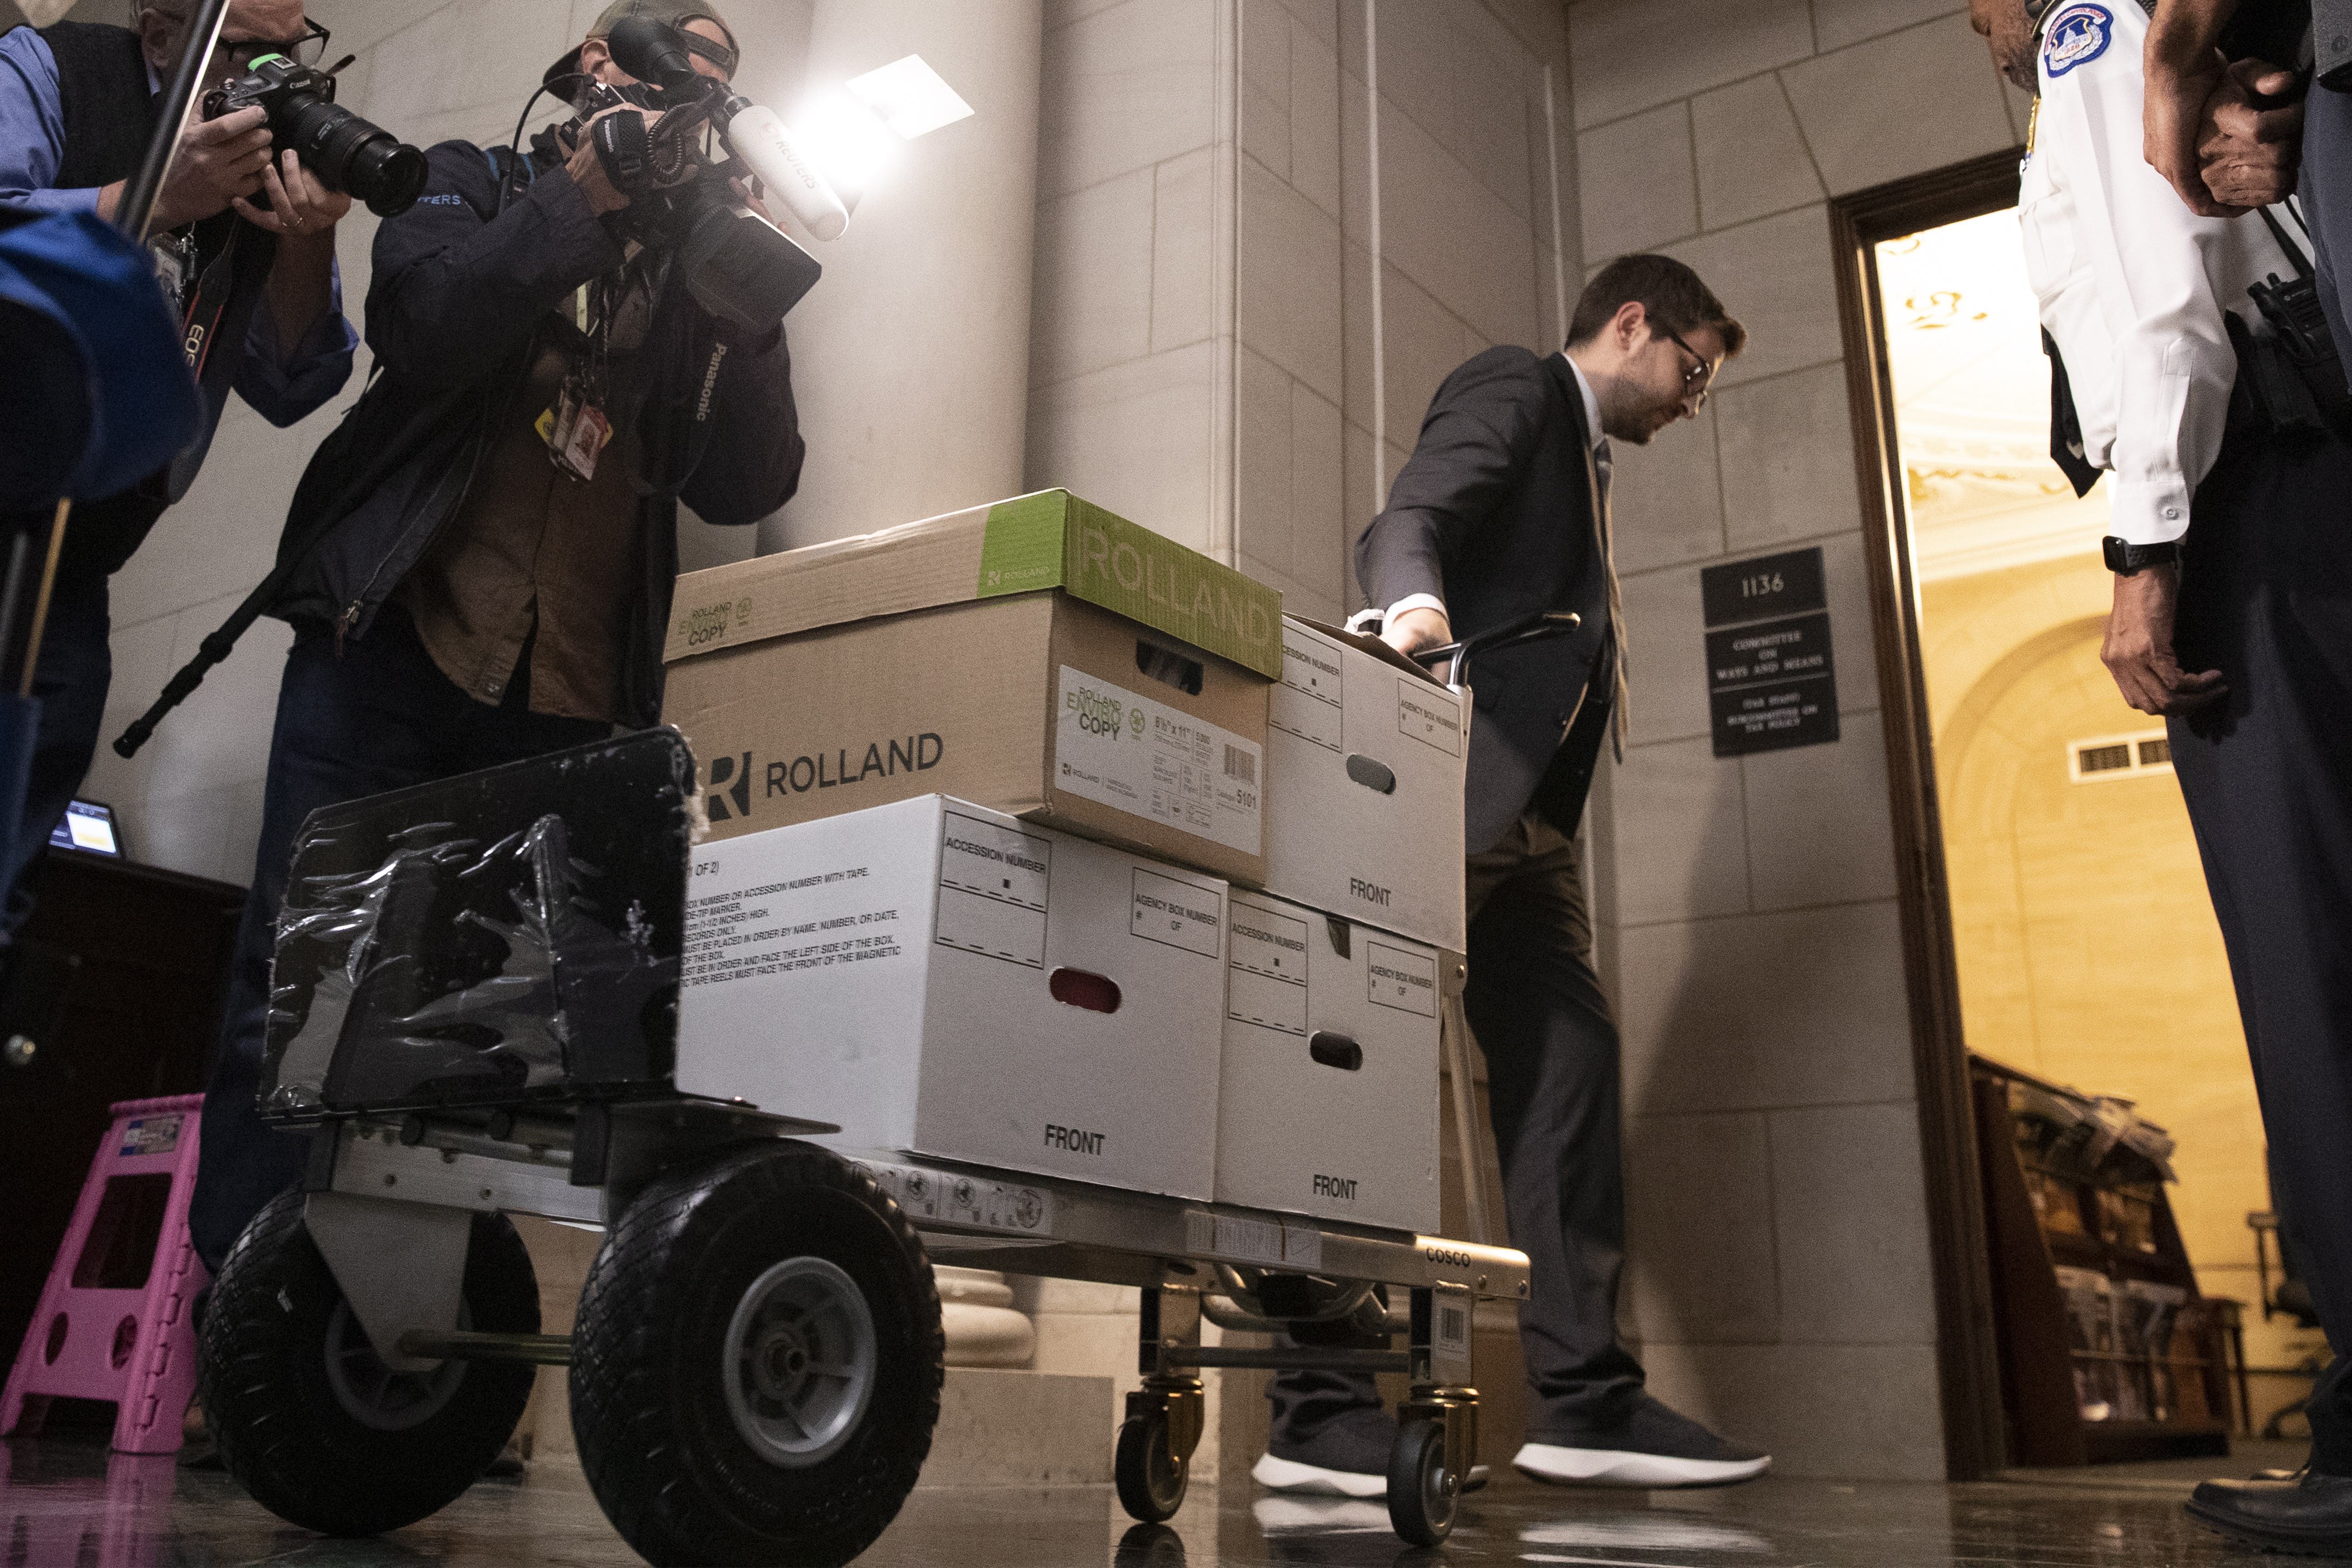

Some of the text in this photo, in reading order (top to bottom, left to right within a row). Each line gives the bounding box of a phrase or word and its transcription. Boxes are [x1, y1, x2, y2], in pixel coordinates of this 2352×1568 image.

[604, 119, 615, 153] Panasonic
[776, 141, 820, 189] REUTERS
[696, 342, 727, 421] Panasonic
[1081, 526, 1270, 646] ROLLAND
[1742, 572, 1784, 598] 1136
[692, 602, 732, 619] ROLLAND
[688, 621, 727, 646] COPY
[1733, 630, 1802, 651] COMMITTEE
[1283, 645, 1340, 677] CESSION NUMBER
[1715, 654, 1824, 680] WAYS AND MEANS
[1759, 648, 1778, 661] ON
[1066, 692, 1122, 726] ENVIRO
[1079, 686, 1122, 711] ROLLAND
[1401, 699, 1423, 716] AGENCY
[1424, 708, 1437, 722] BOX
[1079, 713, 1120, 741] COPY
[767, 732, 944, 798] ROLLAND
[1236, 789, 1257, 810] 5101
[946, 836, 1046, 875] ACCESSION NUMBER
[696, 863, 709, 876] OF
[684, 867, 870, 909] OX NUMBER OR ACCESSION NUMBER WITH TAPE.
[1350, 876, 1392, 906] FRONT
[710, 902, 742, 916] MARKER.
[719, 912, 748, 926] INCHES)
[750, 908, 770, 920] HIGH.
[1135, 894, 1217, 927] AGENCY BOX NUMBER
[702, 941, 713, 951] BE
[714, 936, 743, 949] PLACED
[744, 934, 752, 943] IN
[753, 929, 779, 942] ORDER
[781, 927, 792, 937] BY
[859, 913, 872, 924] OR
[717, 926, 736, 937] ONLY.
[1171, 920, 1182, 932] OF
[1232, 922, 1306, 953] ACCESSION NUMBER
[691, 975, 709, 986] TAPE
[710, 971, 733, 983] REELS
[735, 967, 756, 979] MUST
[757, 965, 777, 975] FACE
[778, 961, 794, 973] THE
[795, 957, 823, 970] FRONT
[824, 955, 836, 966] OF
[838, 952, 854, 964] THE
[855, 946, 902, 961] MAGNETIC
[693, 953, 707, 963] THE
[709, 950, 725, 961] BOX.
[697, 964, 707, 975] BE
[708, 962, 715, 972] IN
[717, 958, 743, 971] ORDER
[744, 955, 760, 966] AND
[761, 951, 781, 962] FACE
[783, 949, 798, 960] THE
[799, 946, 819, 958] LEFT
[821, 942, 840, 954] SIDE
[842, 940, 854, 951] OF
[856, 937, 872, 949] THE
[874, 935, 895, 946] BOX.
[1370, 965, 1433, 989] AGENCY BOX NUMBER
[1398, 986, 1407, 996] OF
[1044, 1123, 1106, 1156] FRONT
[1313, 1174, 1358, 1200] FRONT
[1426, 1246, 1470, 1268] COSCO
